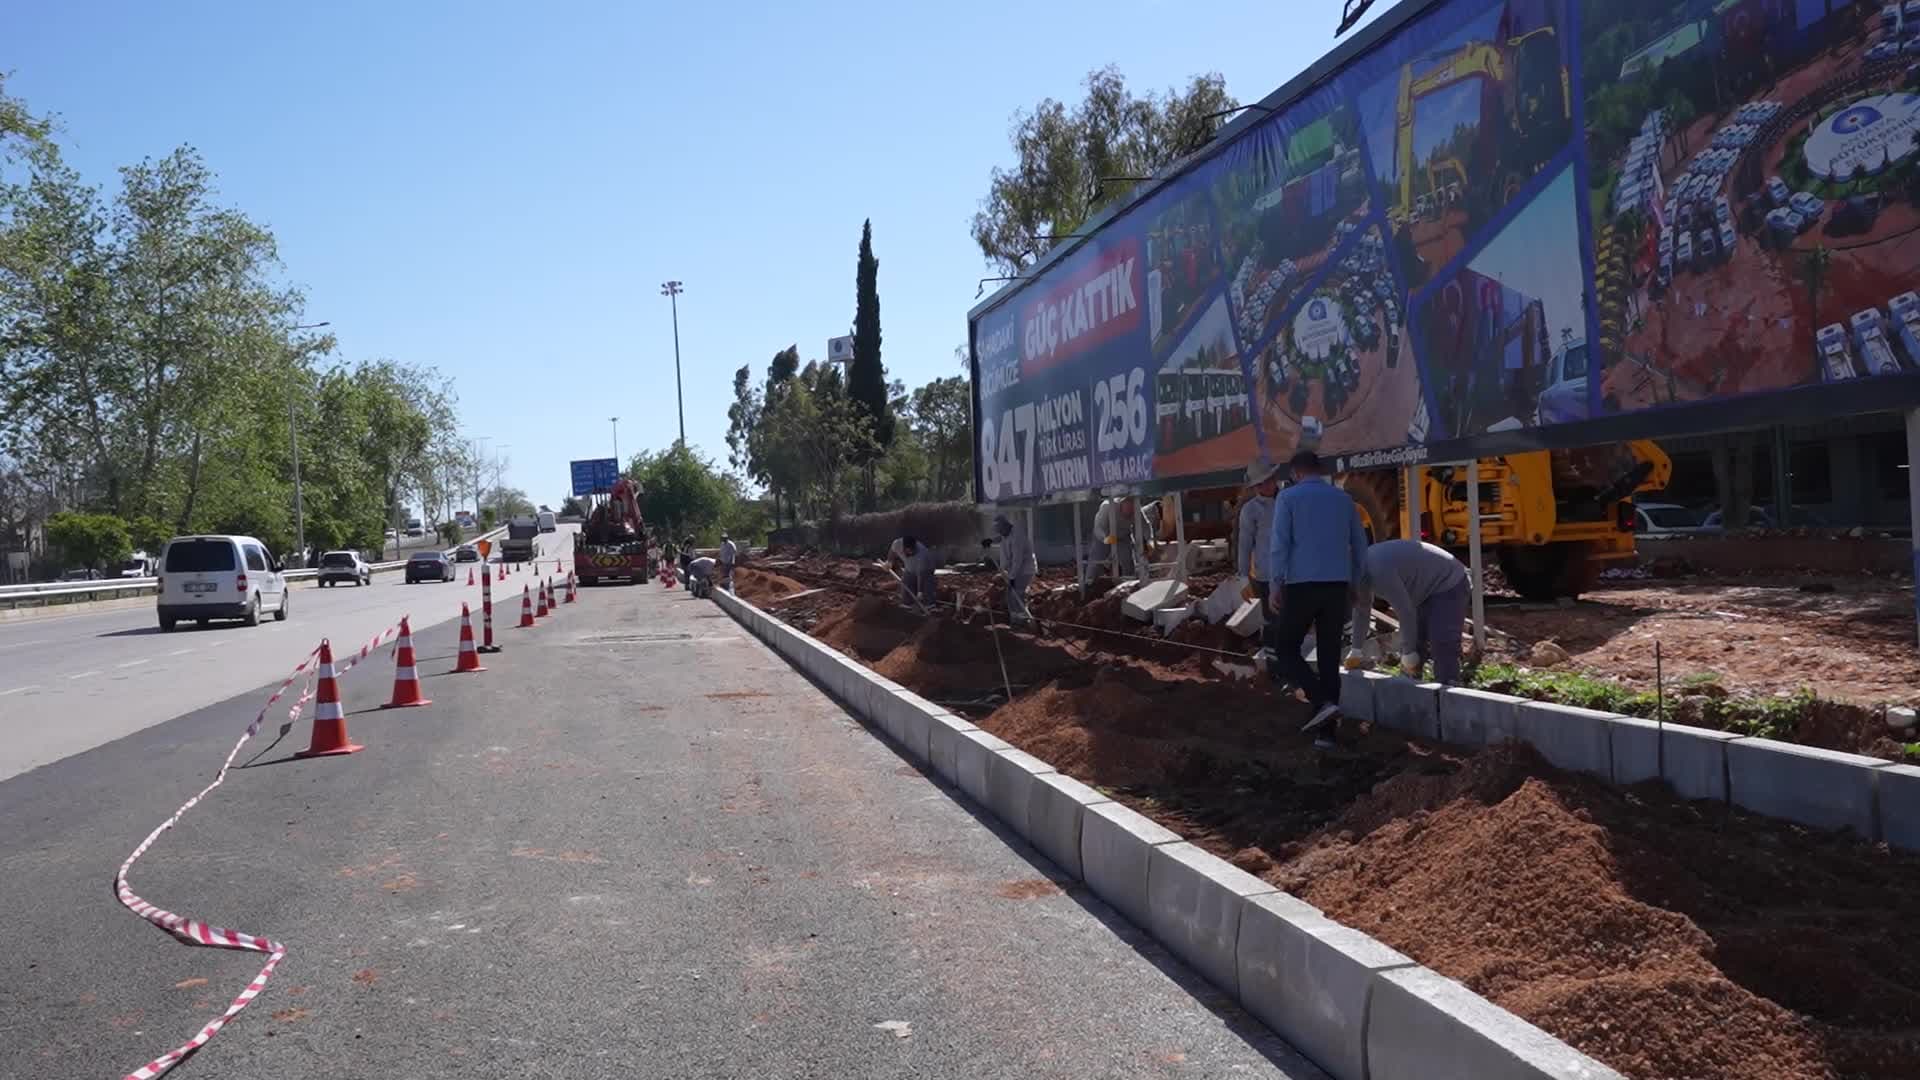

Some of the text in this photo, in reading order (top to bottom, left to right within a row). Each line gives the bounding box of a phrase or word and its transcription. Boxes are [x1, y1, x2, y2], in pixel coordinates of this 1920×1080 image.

[1025, 257, 1136, 361] GÜÇ KATTIK
[1037, 390, 1083, 432] MİLYON
[1094, 367, 1148, 452] 256
[981, 402, 1036, 500] 847
[1039, 430, 1086, 457] TÜRK LİRASI
[1042, 456, 1090, 491] YATIRIM
[1123, 452, 1152, 481] ARAÇ
